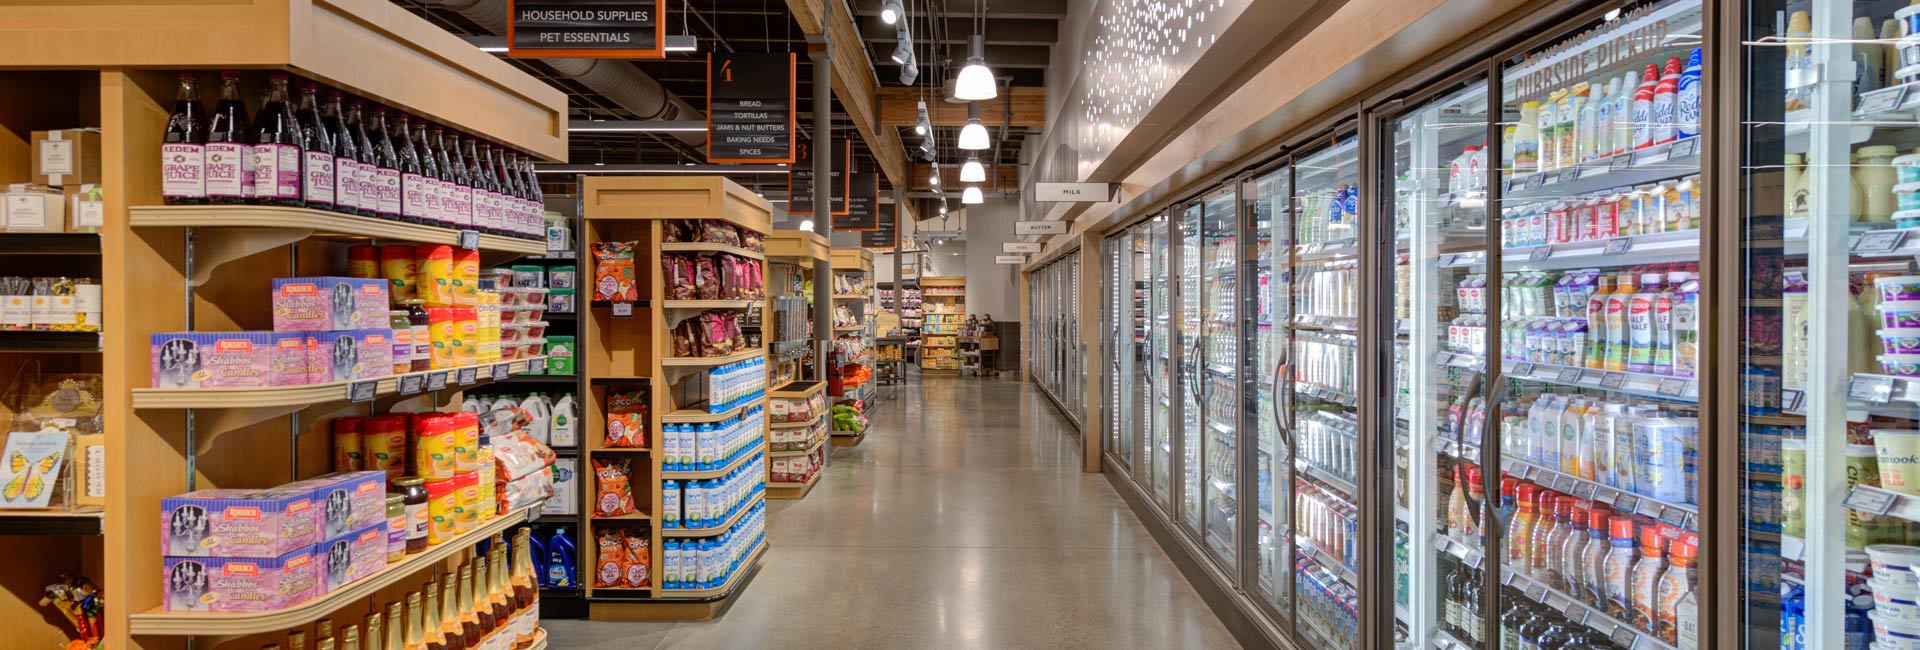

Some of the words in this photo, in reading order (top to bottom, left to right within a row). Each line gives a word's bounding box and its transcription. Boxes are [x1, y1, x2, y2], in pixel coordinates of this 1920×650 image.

[522, 10, 594, 21] HOUSEHOLD
[596, 11, 648, 22] SUPPLIES
[1545, 44, 1558, 58] US
[1562, 29, 1592, 53] SHOP
[1596, 18, 1620, 34] FOR
[1624, 2, 1654, 22] YOU
[540, 32, 560, 42] PET
[564, 32, 630, 42] ESSENTIALS
[1515, 51, 1590, 104] CURBSIDE
[1596, 18, 1668, 73] PICKUP
[798, 144, 807, 160] 3
[164, 164, 199, 172] GRAPE
[164, 172, 199, 180] JUICE
[276, 299, 316, 309] Shabbos
[287, 310, 325, 320] Candles
[210, 356, 252, 366] Shabbos
[220, 368, 260, 377] Candles
[219, 523, 260, 533] Shabbos
[1660, 526, 1680, 540] sale
[228, 535, 269, 545] Candles
[217, 579, 257, 589] Shabbos
[227, 590, 267, 601] Candles
